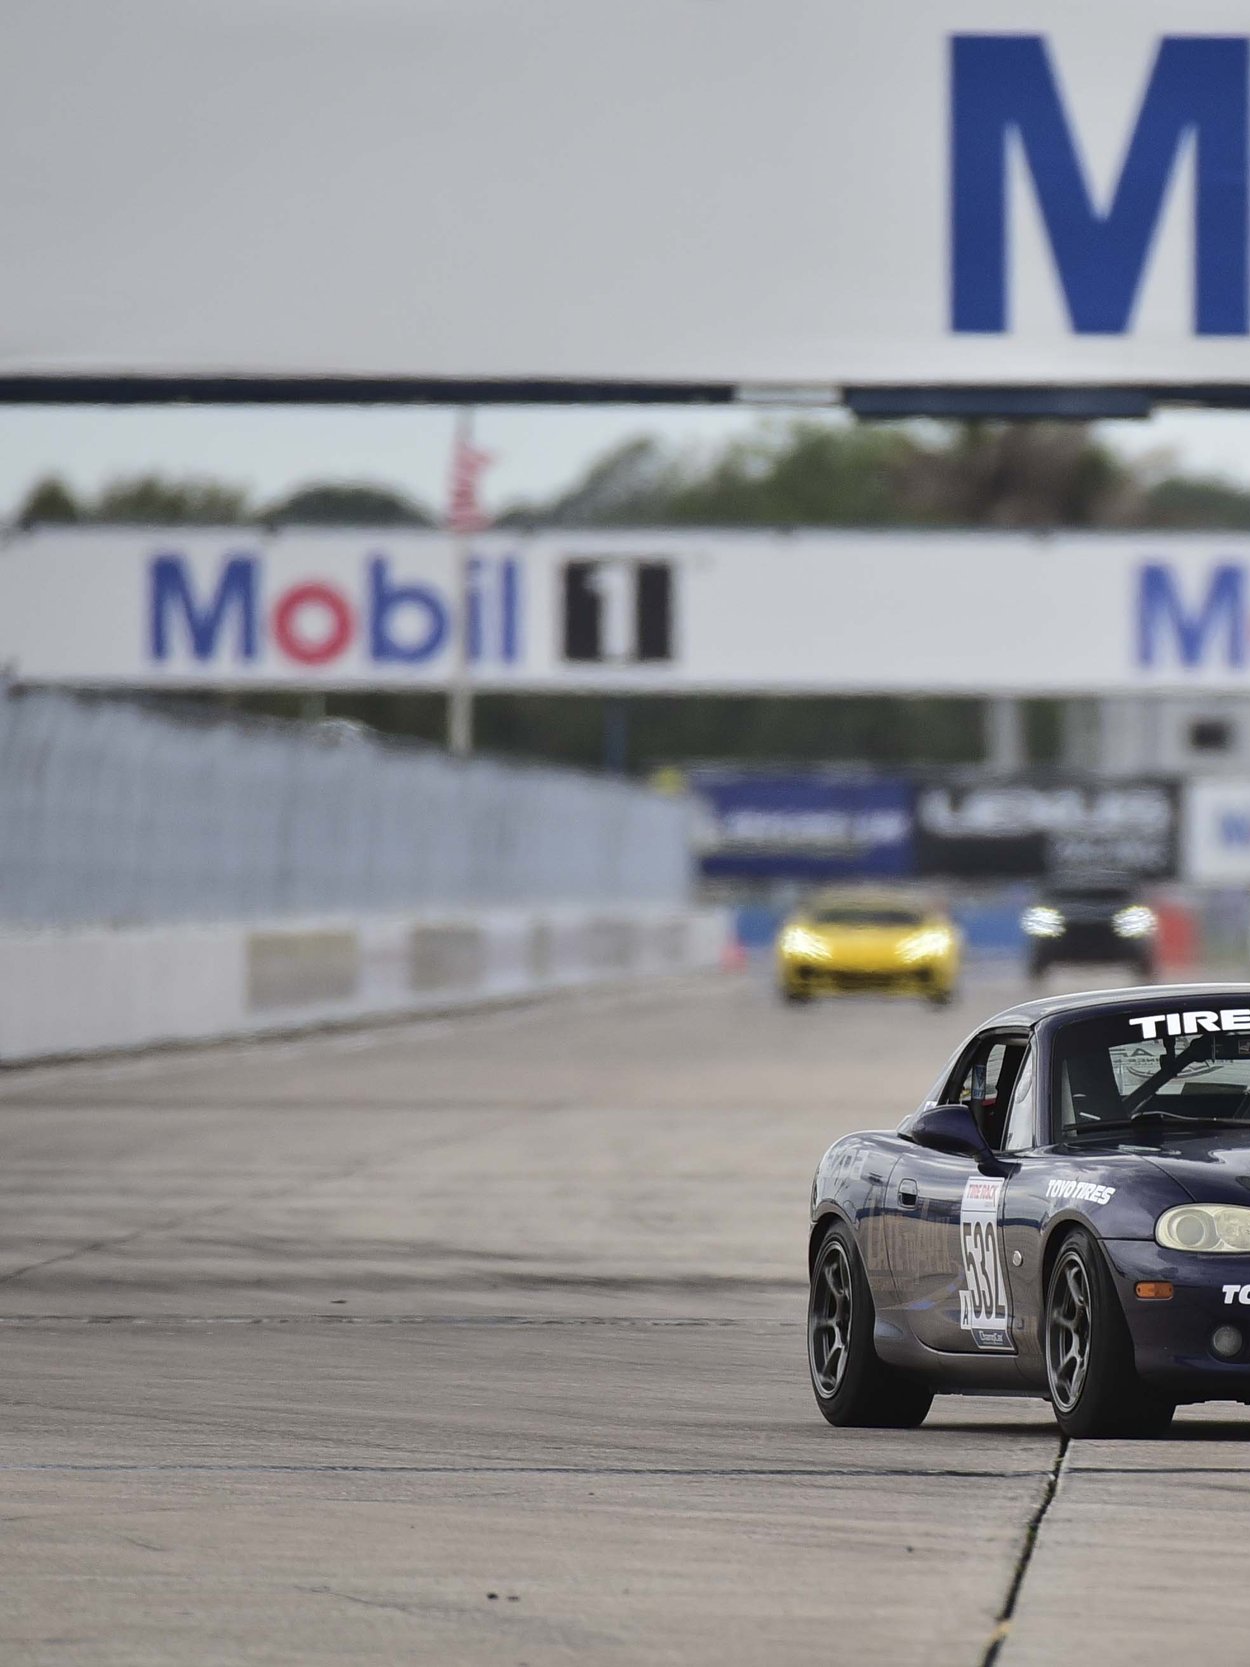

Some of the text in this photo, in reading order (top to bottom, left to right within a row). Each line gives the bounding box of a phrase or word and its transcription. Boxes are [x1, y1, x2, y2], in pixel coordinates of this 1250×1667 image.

[147, 554, 521, 667] Mobil
[1046, 1179, 1116, 1205] TOYO TIRES
[963, 1221, 1006, 1320] 532
